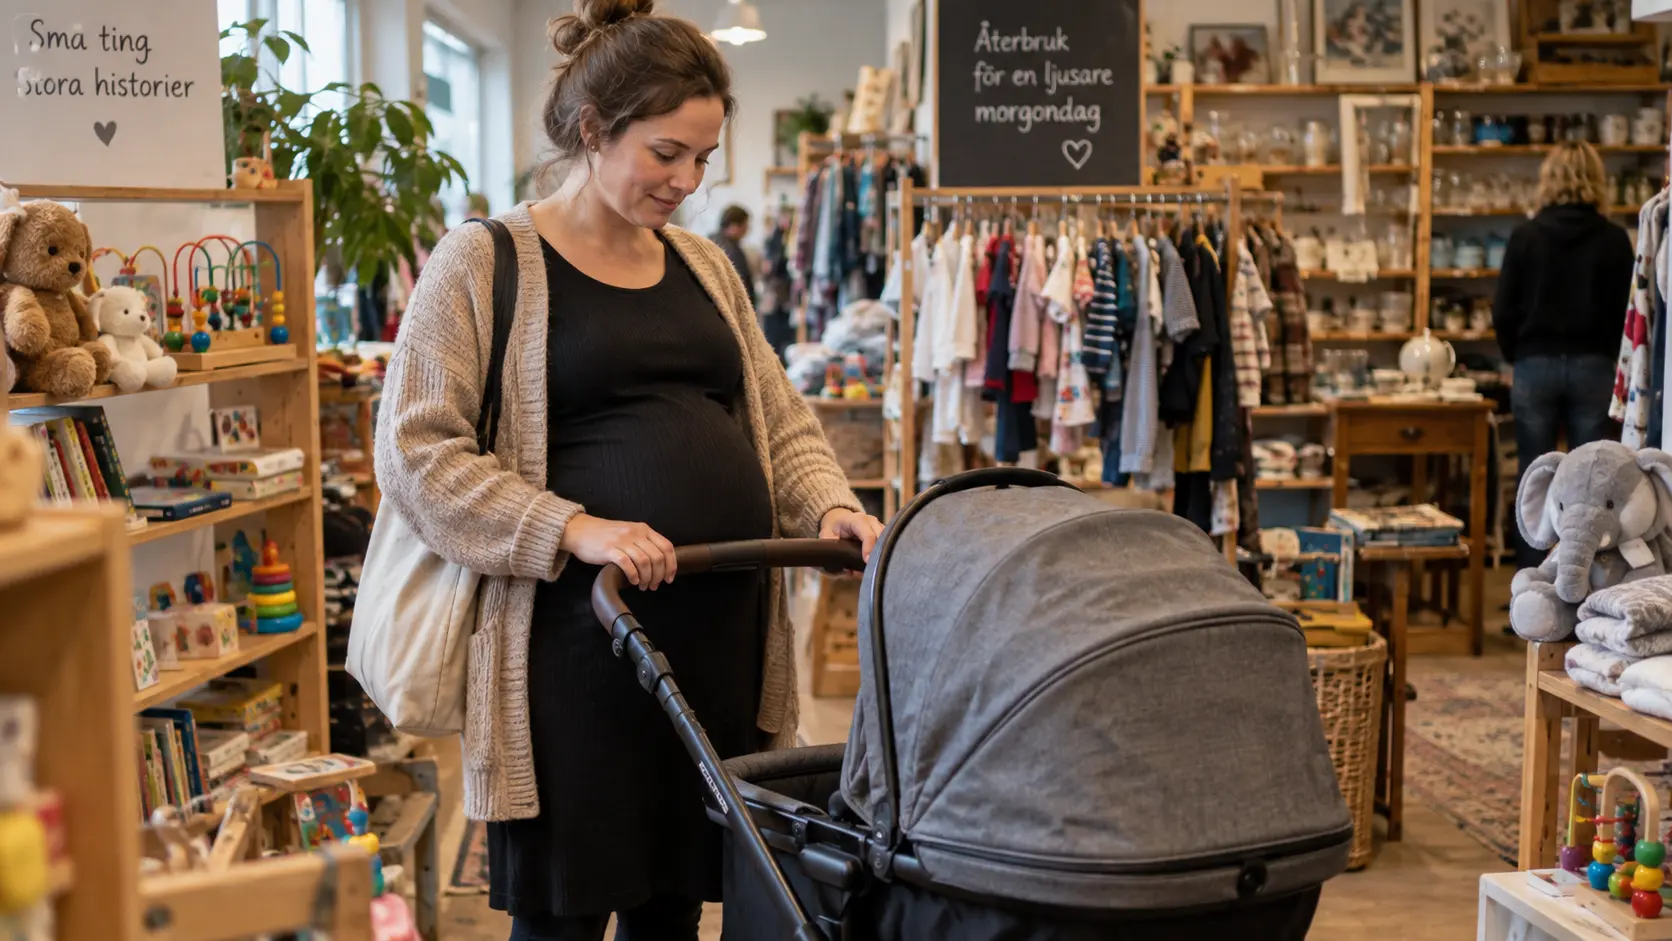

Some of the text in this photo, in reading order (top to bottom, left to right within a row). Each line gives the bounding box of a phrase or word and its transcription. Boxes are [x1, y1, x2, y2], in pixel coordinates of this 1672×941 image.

[98, 24, 152, 65] ting
[974, 20, 1070, 53] Återbruk
[94, 66, 195, 98] historier
[973, 60, 1114, 95] för en ljusare
[974, 96, 1101, 133] morgondag
